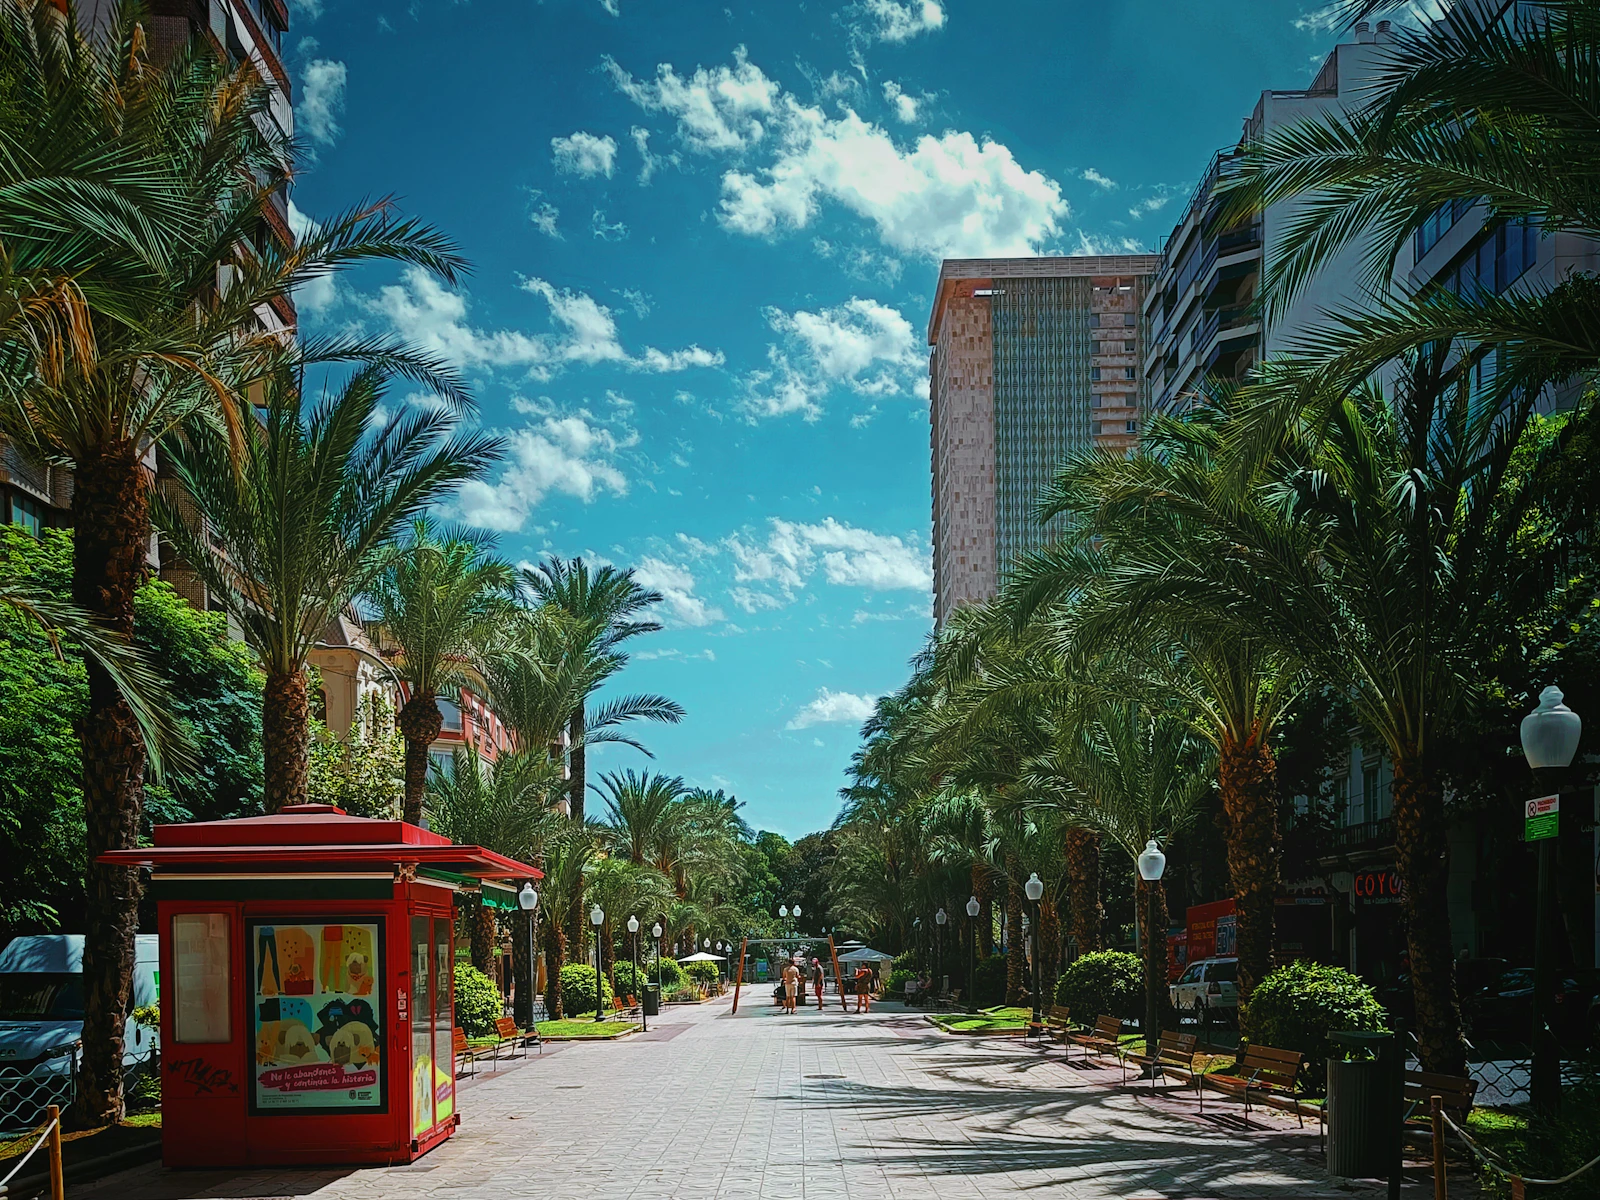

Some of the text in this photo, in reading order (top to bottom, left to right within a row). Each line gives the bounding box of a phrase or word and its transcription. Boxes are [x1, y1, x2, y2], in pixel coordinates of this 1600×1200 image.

[270, 1067, 337, 1081] No le abandones
[284, 1081, 291, 1091] y
[331, 1076, 340, 1084] la
[341, 1073, 375, 1084] historia
